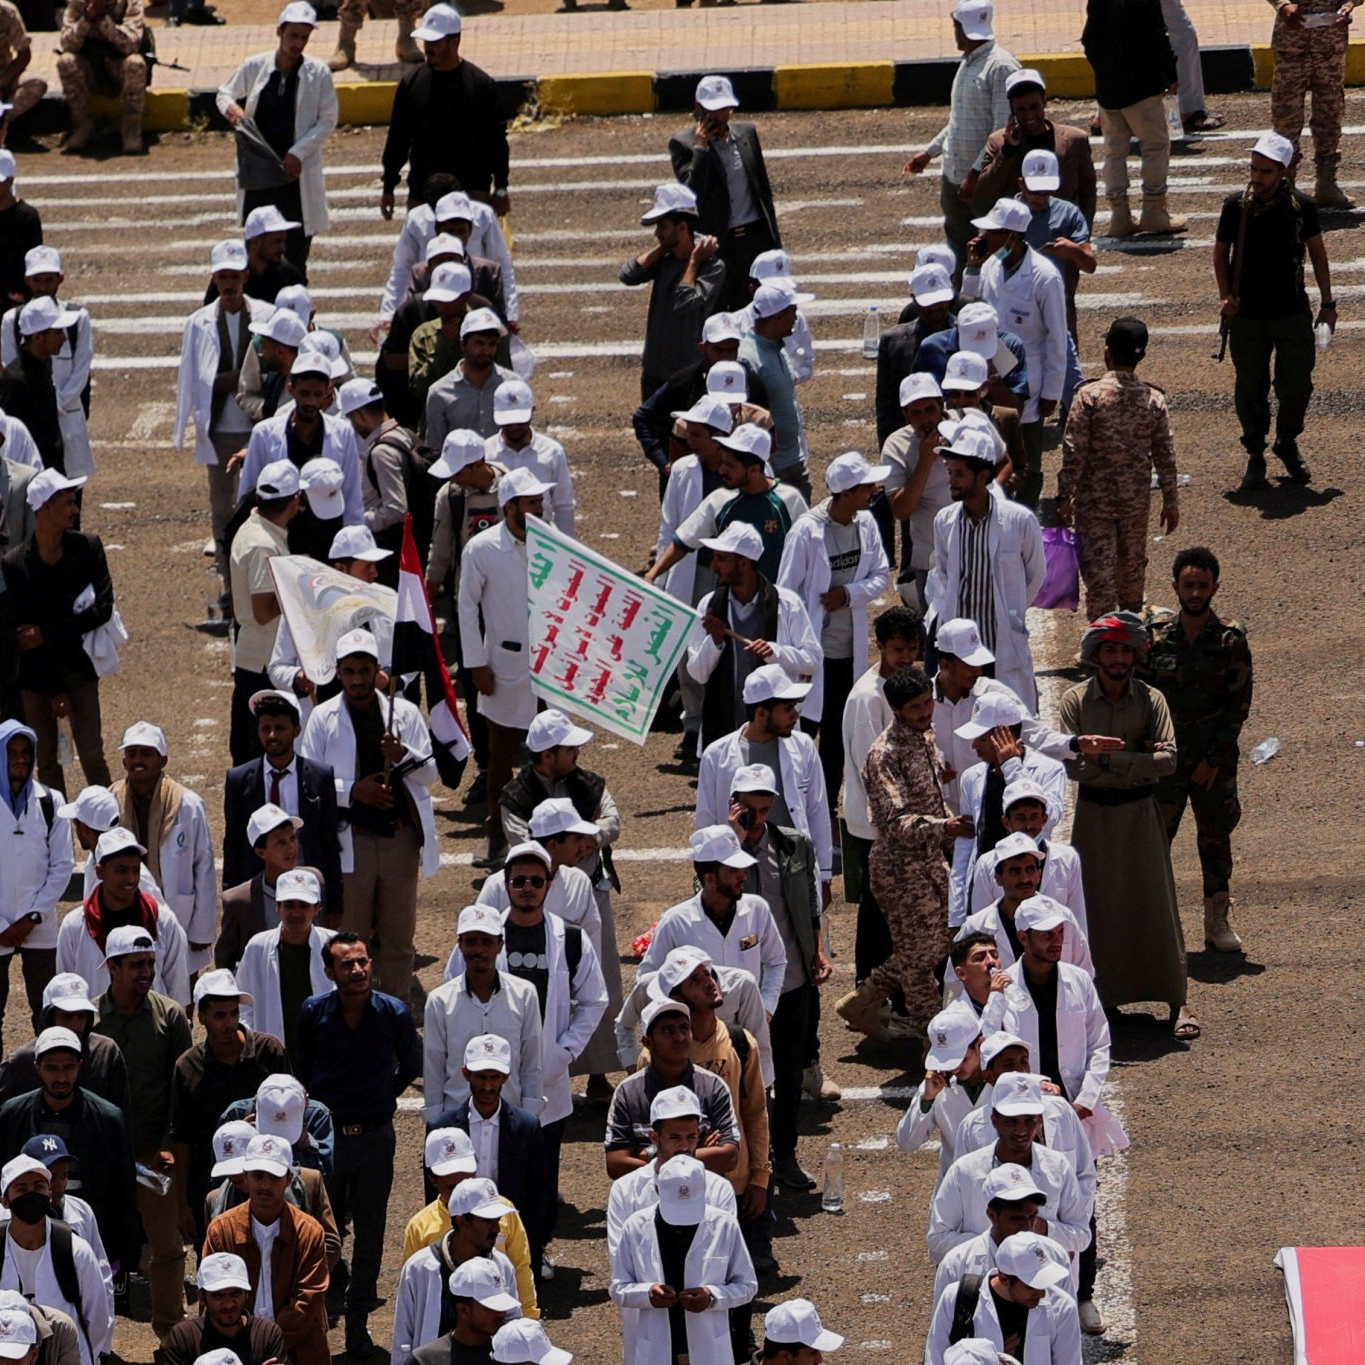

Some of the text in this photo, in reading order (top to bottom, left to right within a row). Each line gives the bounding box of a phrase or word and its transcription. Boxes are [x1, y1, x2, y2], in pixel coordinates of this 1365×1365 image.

[528, 539, 557, 590] الله
[556, 558, 587, 612] الموت
[585, 574, 616, 627] الموت
[584, 589, 646, 705] اللعنة على اليهود
[609, 603, 676, 724] النصر للإسلام
[42, 1138, 58, 1151] NY
